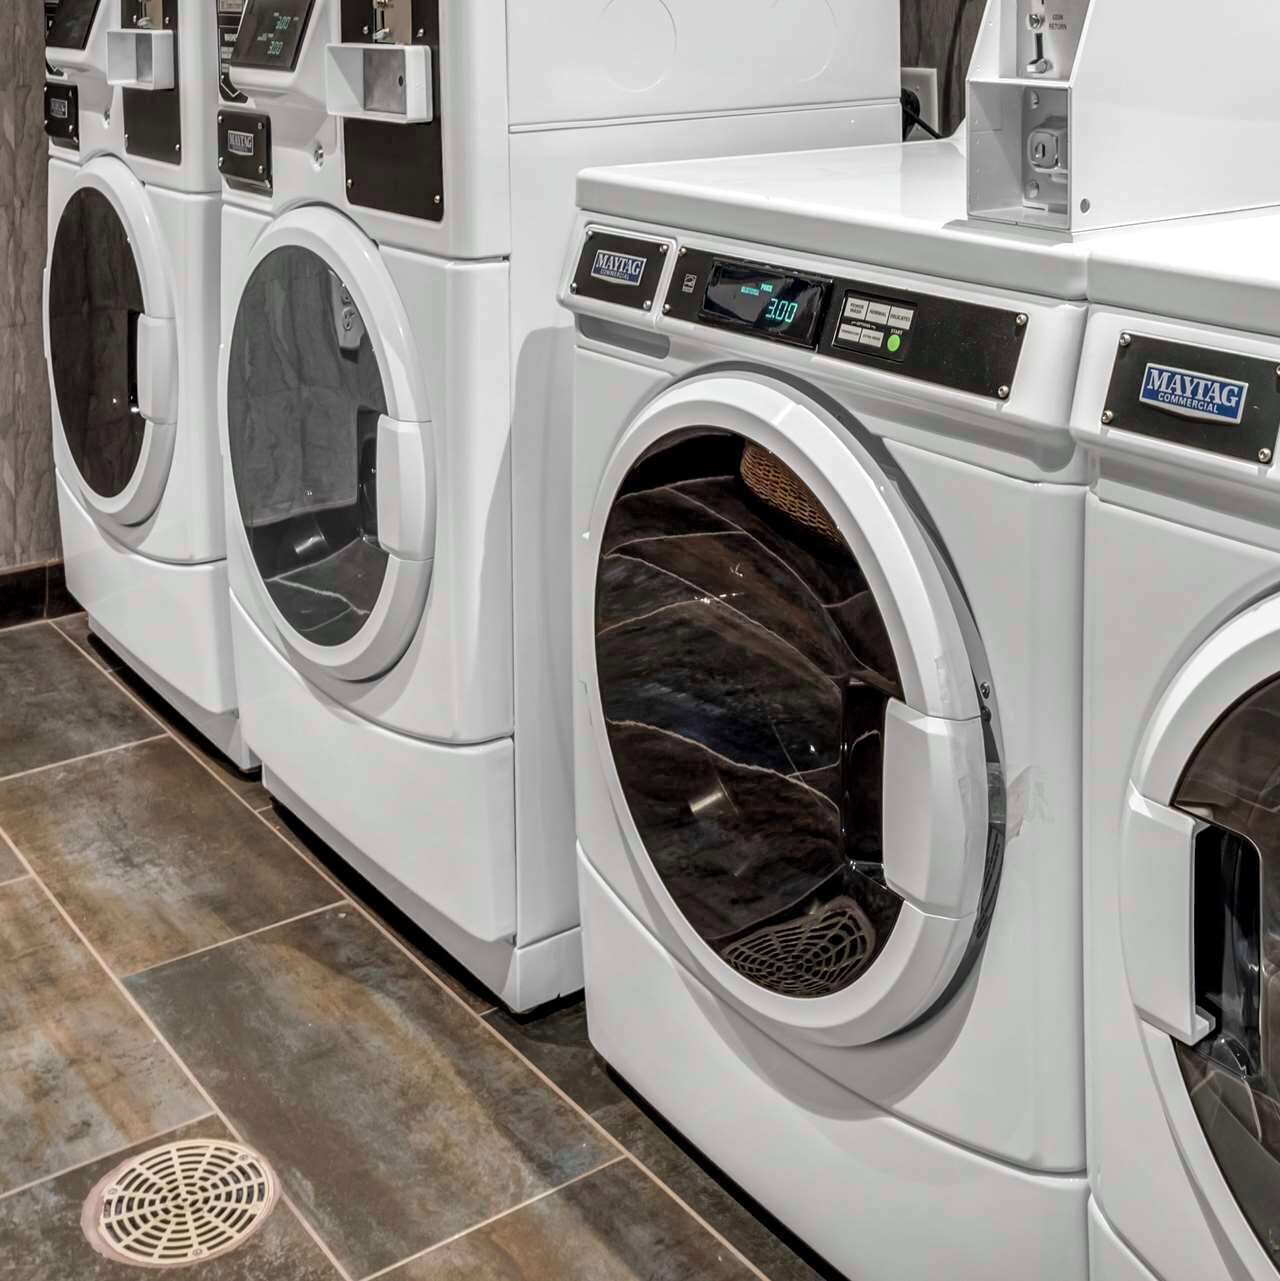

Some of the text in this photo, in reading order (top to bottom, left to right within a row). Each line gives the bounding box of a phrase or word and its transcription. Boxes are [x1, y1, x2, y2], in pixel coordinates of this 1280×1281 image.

[596, 253, 641, 275] MAYTAG
[765, 298, 798, 323] 3.00
[1147, 369, 1239, 408] MAYTAG
[1158, 392, 1219, 414] COMMERCIAL
